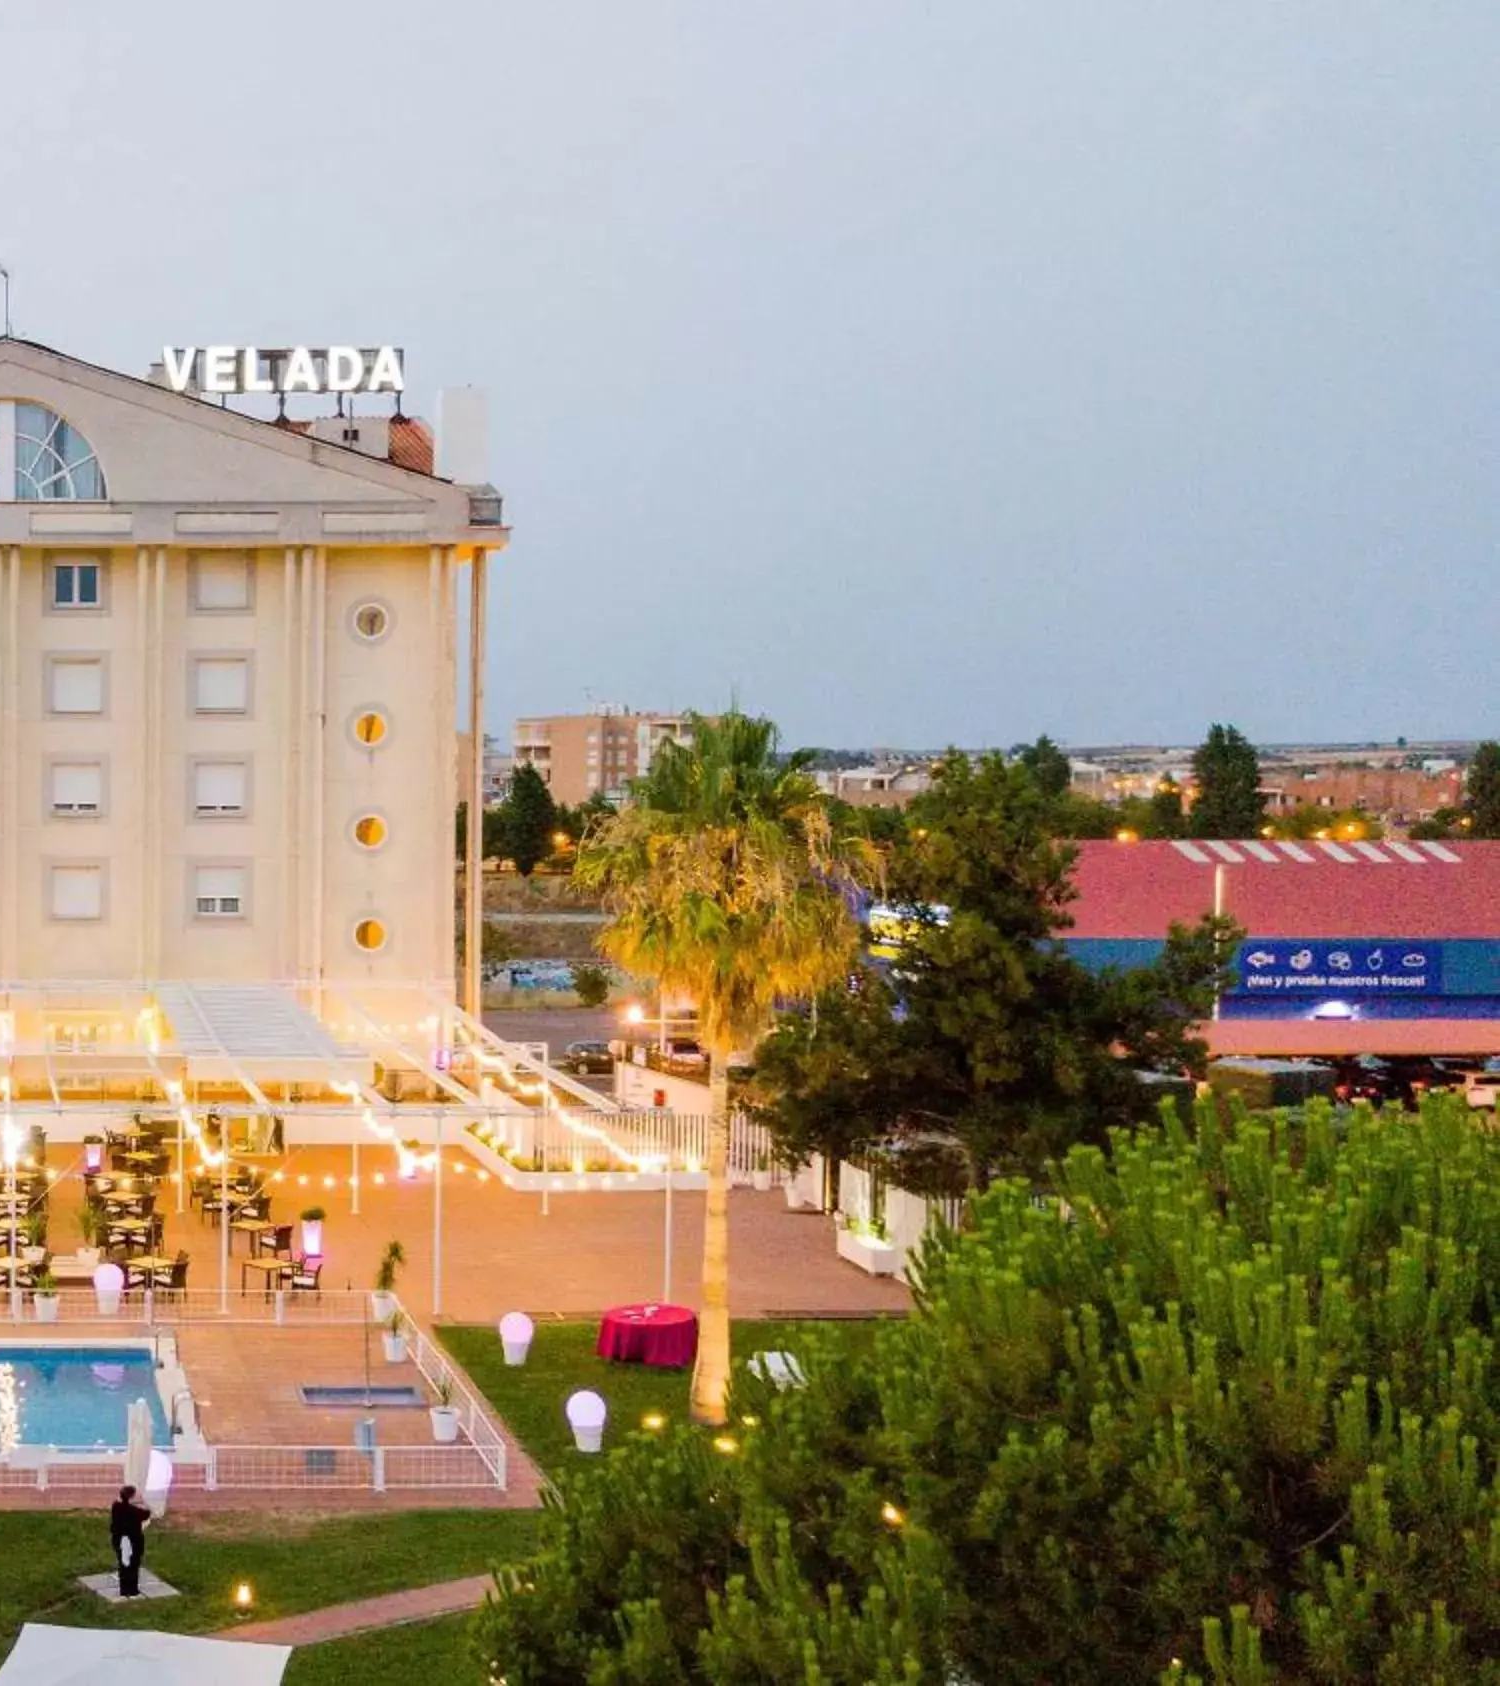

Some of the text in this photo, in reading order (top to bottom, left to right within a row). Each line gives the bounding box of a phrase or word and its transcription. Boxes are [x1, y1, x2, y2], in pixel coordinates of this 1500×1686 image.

[163, 346, 405, 391] VELADA
[1284, 975, 1326, 988] prueba
[1328, 976, 1378, 987] nuestros
